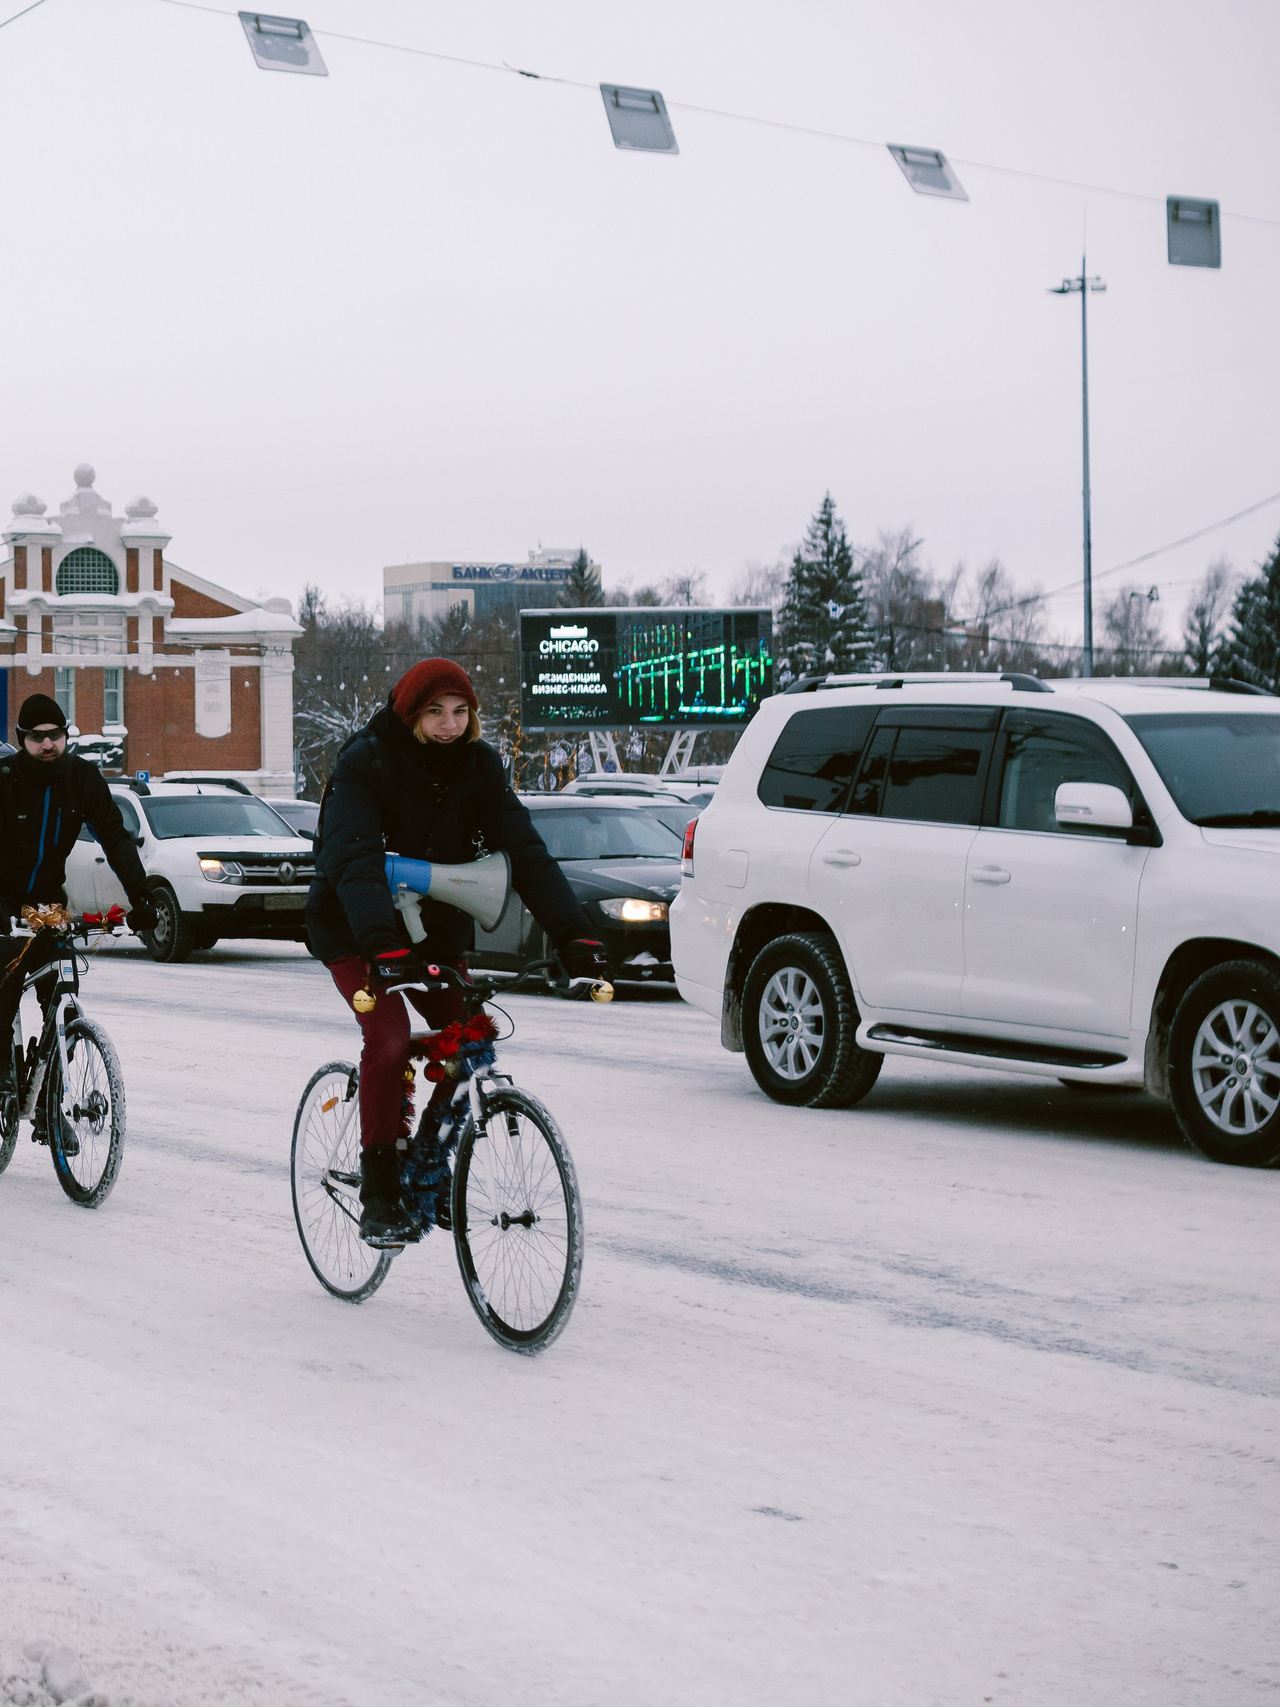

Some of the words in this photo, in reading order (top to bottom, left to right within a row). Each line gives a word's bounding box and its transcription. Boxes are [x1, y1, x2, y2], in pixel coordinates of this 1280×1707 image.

[452, 565, 493, 579] БАНК
[521, 566, 572, 581] АКЦЕП
[539, 639, 599, 654] CHICAGO
[538, 672, 601, 684] РЕЗИДЕНЦИИ
[532, 684, 607, 695] БИЗНЕС-КЛАССА
